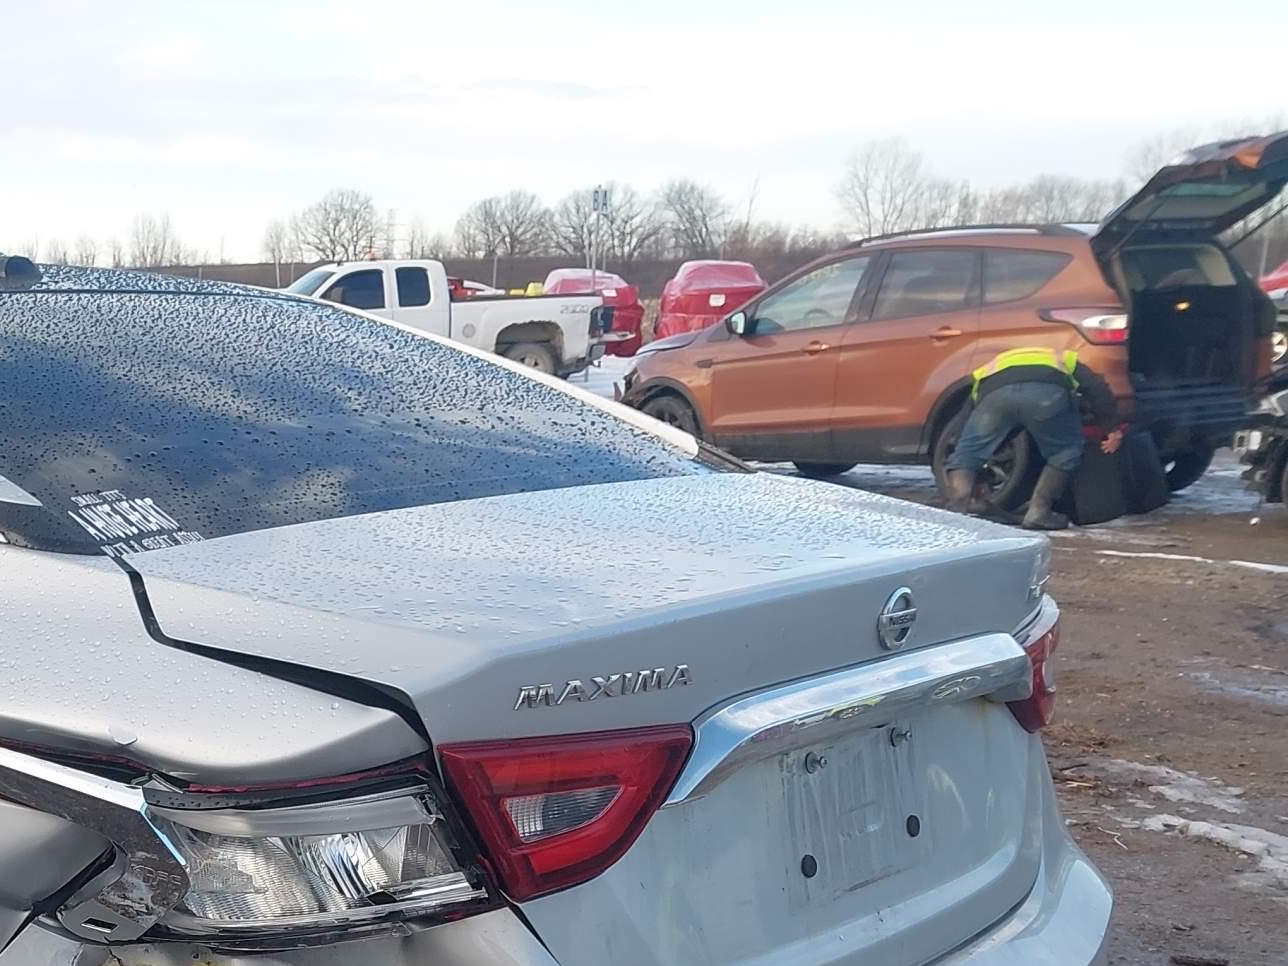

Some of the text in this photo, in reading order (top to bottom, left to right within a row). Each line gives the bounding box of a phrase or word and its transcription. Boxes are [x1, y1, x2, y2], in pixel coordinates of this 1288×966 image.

[67, 497, 180, 541] A HUGE HEART
[513, 664, 694, 711] MAXIMA
